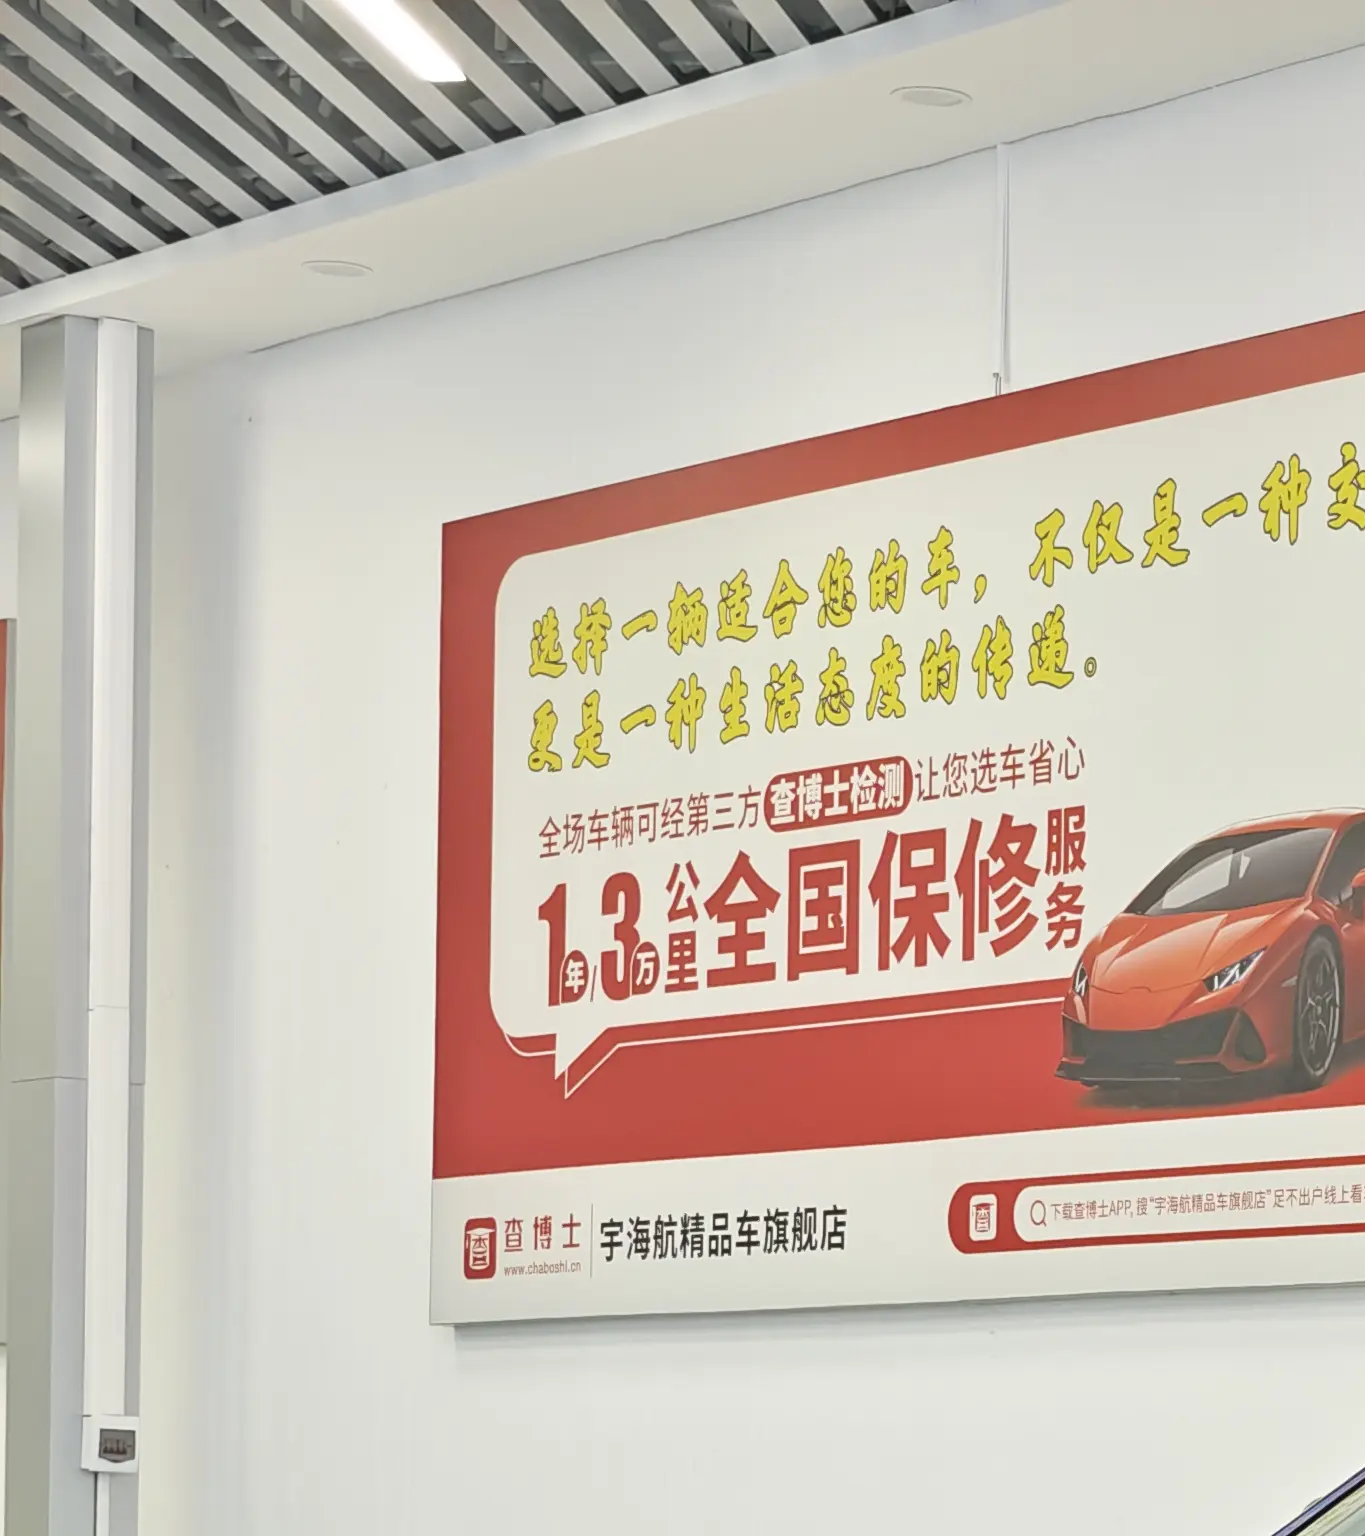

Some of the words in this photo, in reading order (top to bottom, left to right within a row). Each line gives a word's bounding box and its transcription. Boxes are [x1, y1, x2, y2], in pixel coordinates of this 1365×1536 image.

[503, 1212, 582, 1253] 查博士
[600, 1204, 848, 1263] 宇海航精品车旗舰店
